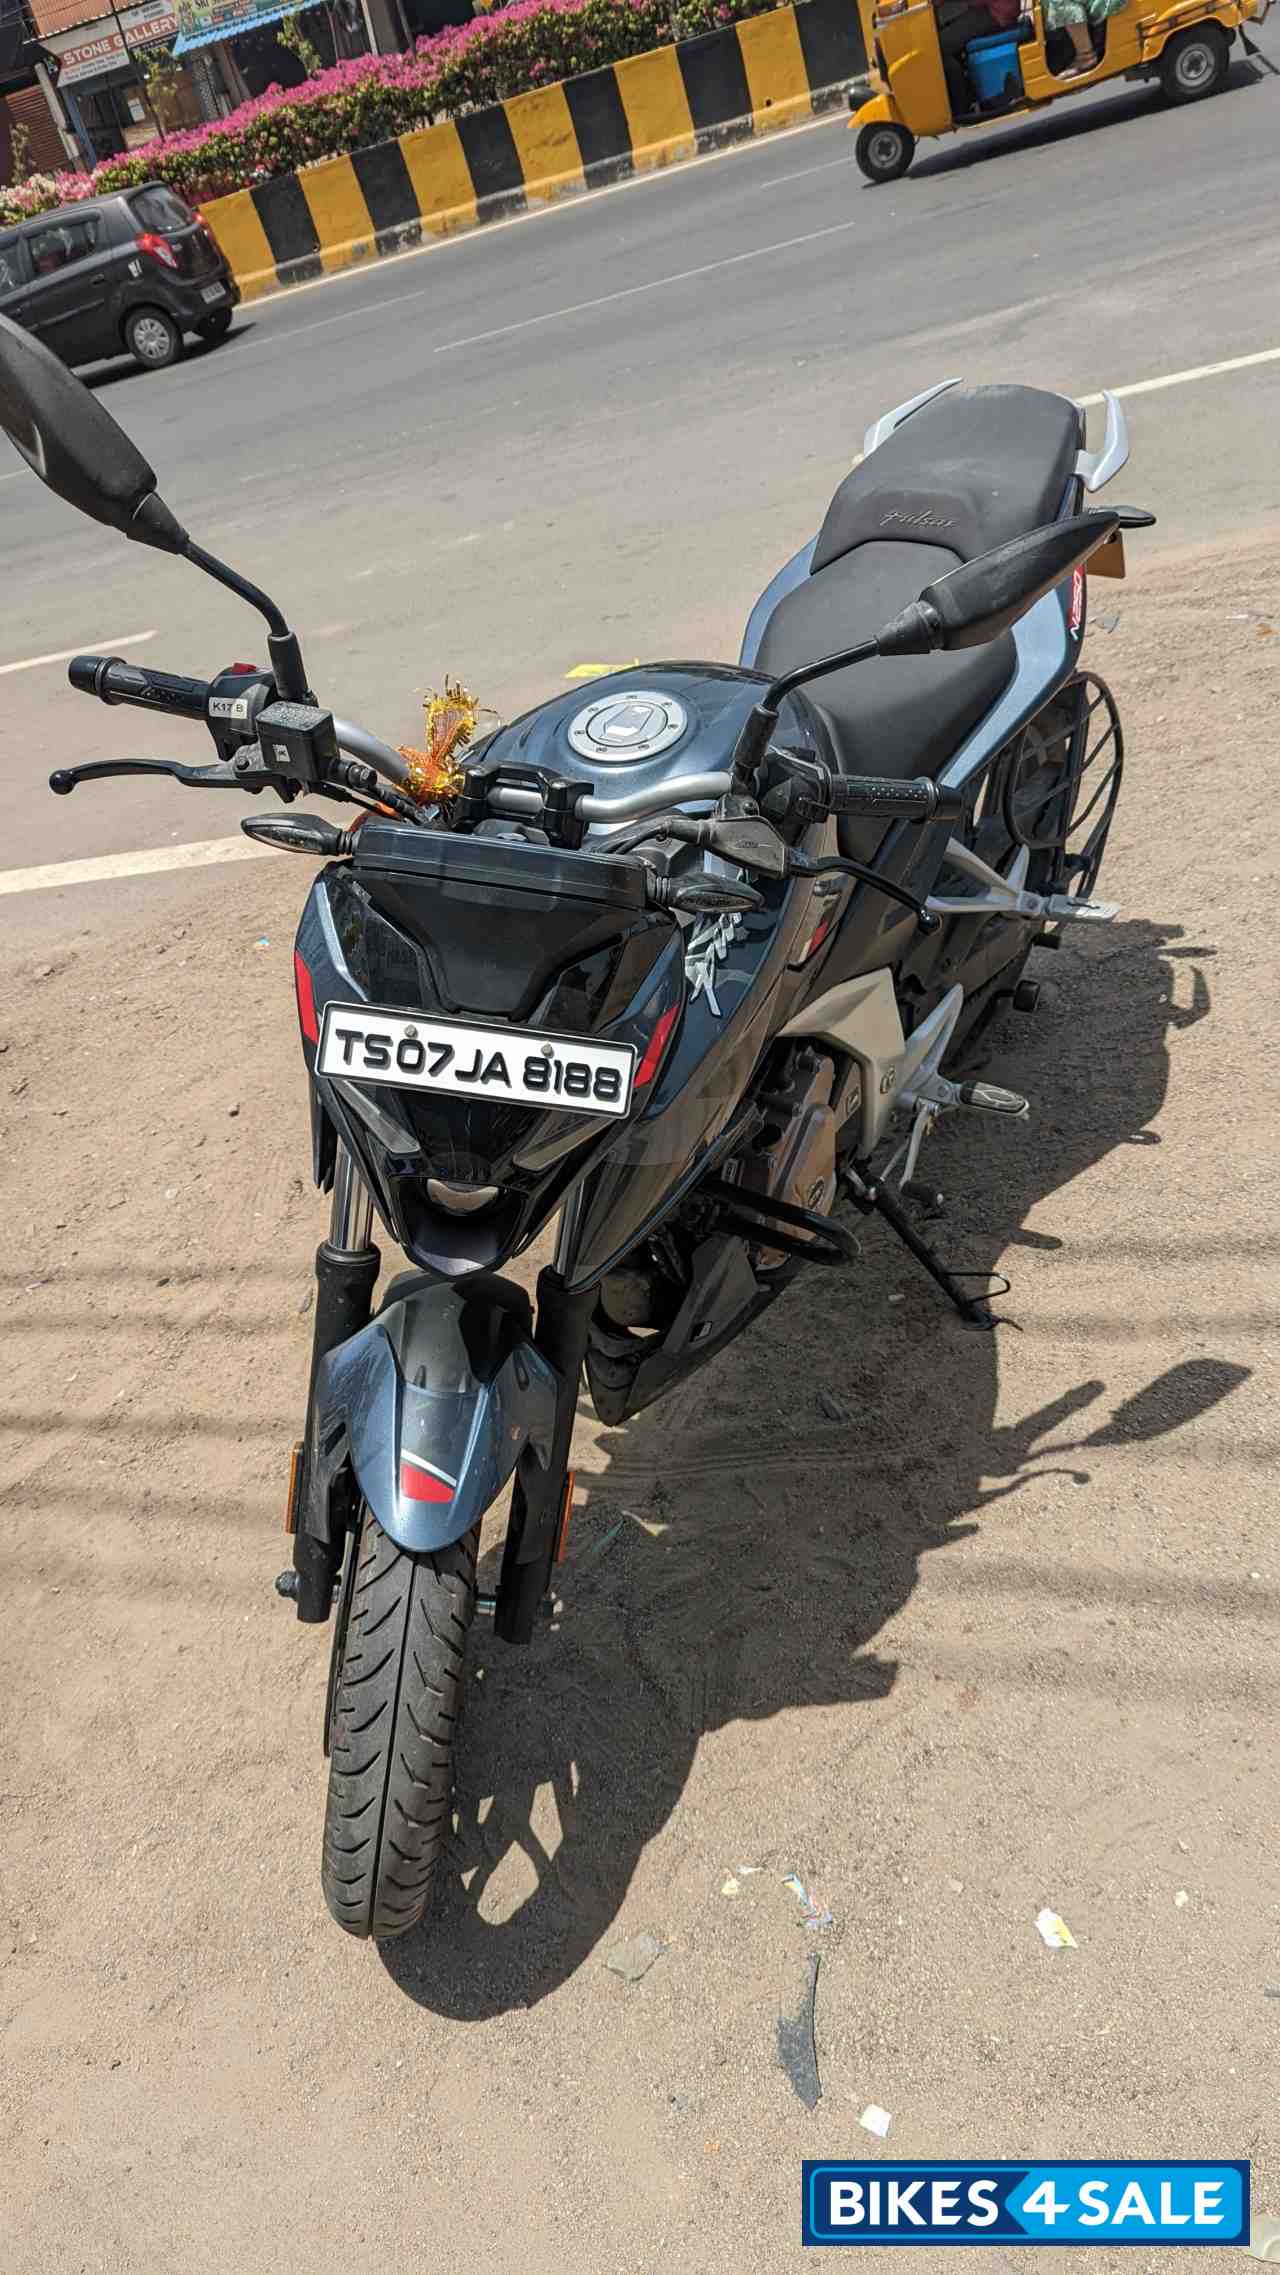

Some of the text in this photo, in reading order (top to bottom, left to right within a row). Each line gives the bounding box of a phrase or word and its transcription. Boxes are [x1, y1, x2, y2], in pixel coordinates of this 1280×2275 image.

[63, 15, 178, 65] STONE GALLERY
[523, 1055, 622, 1103] 8188
